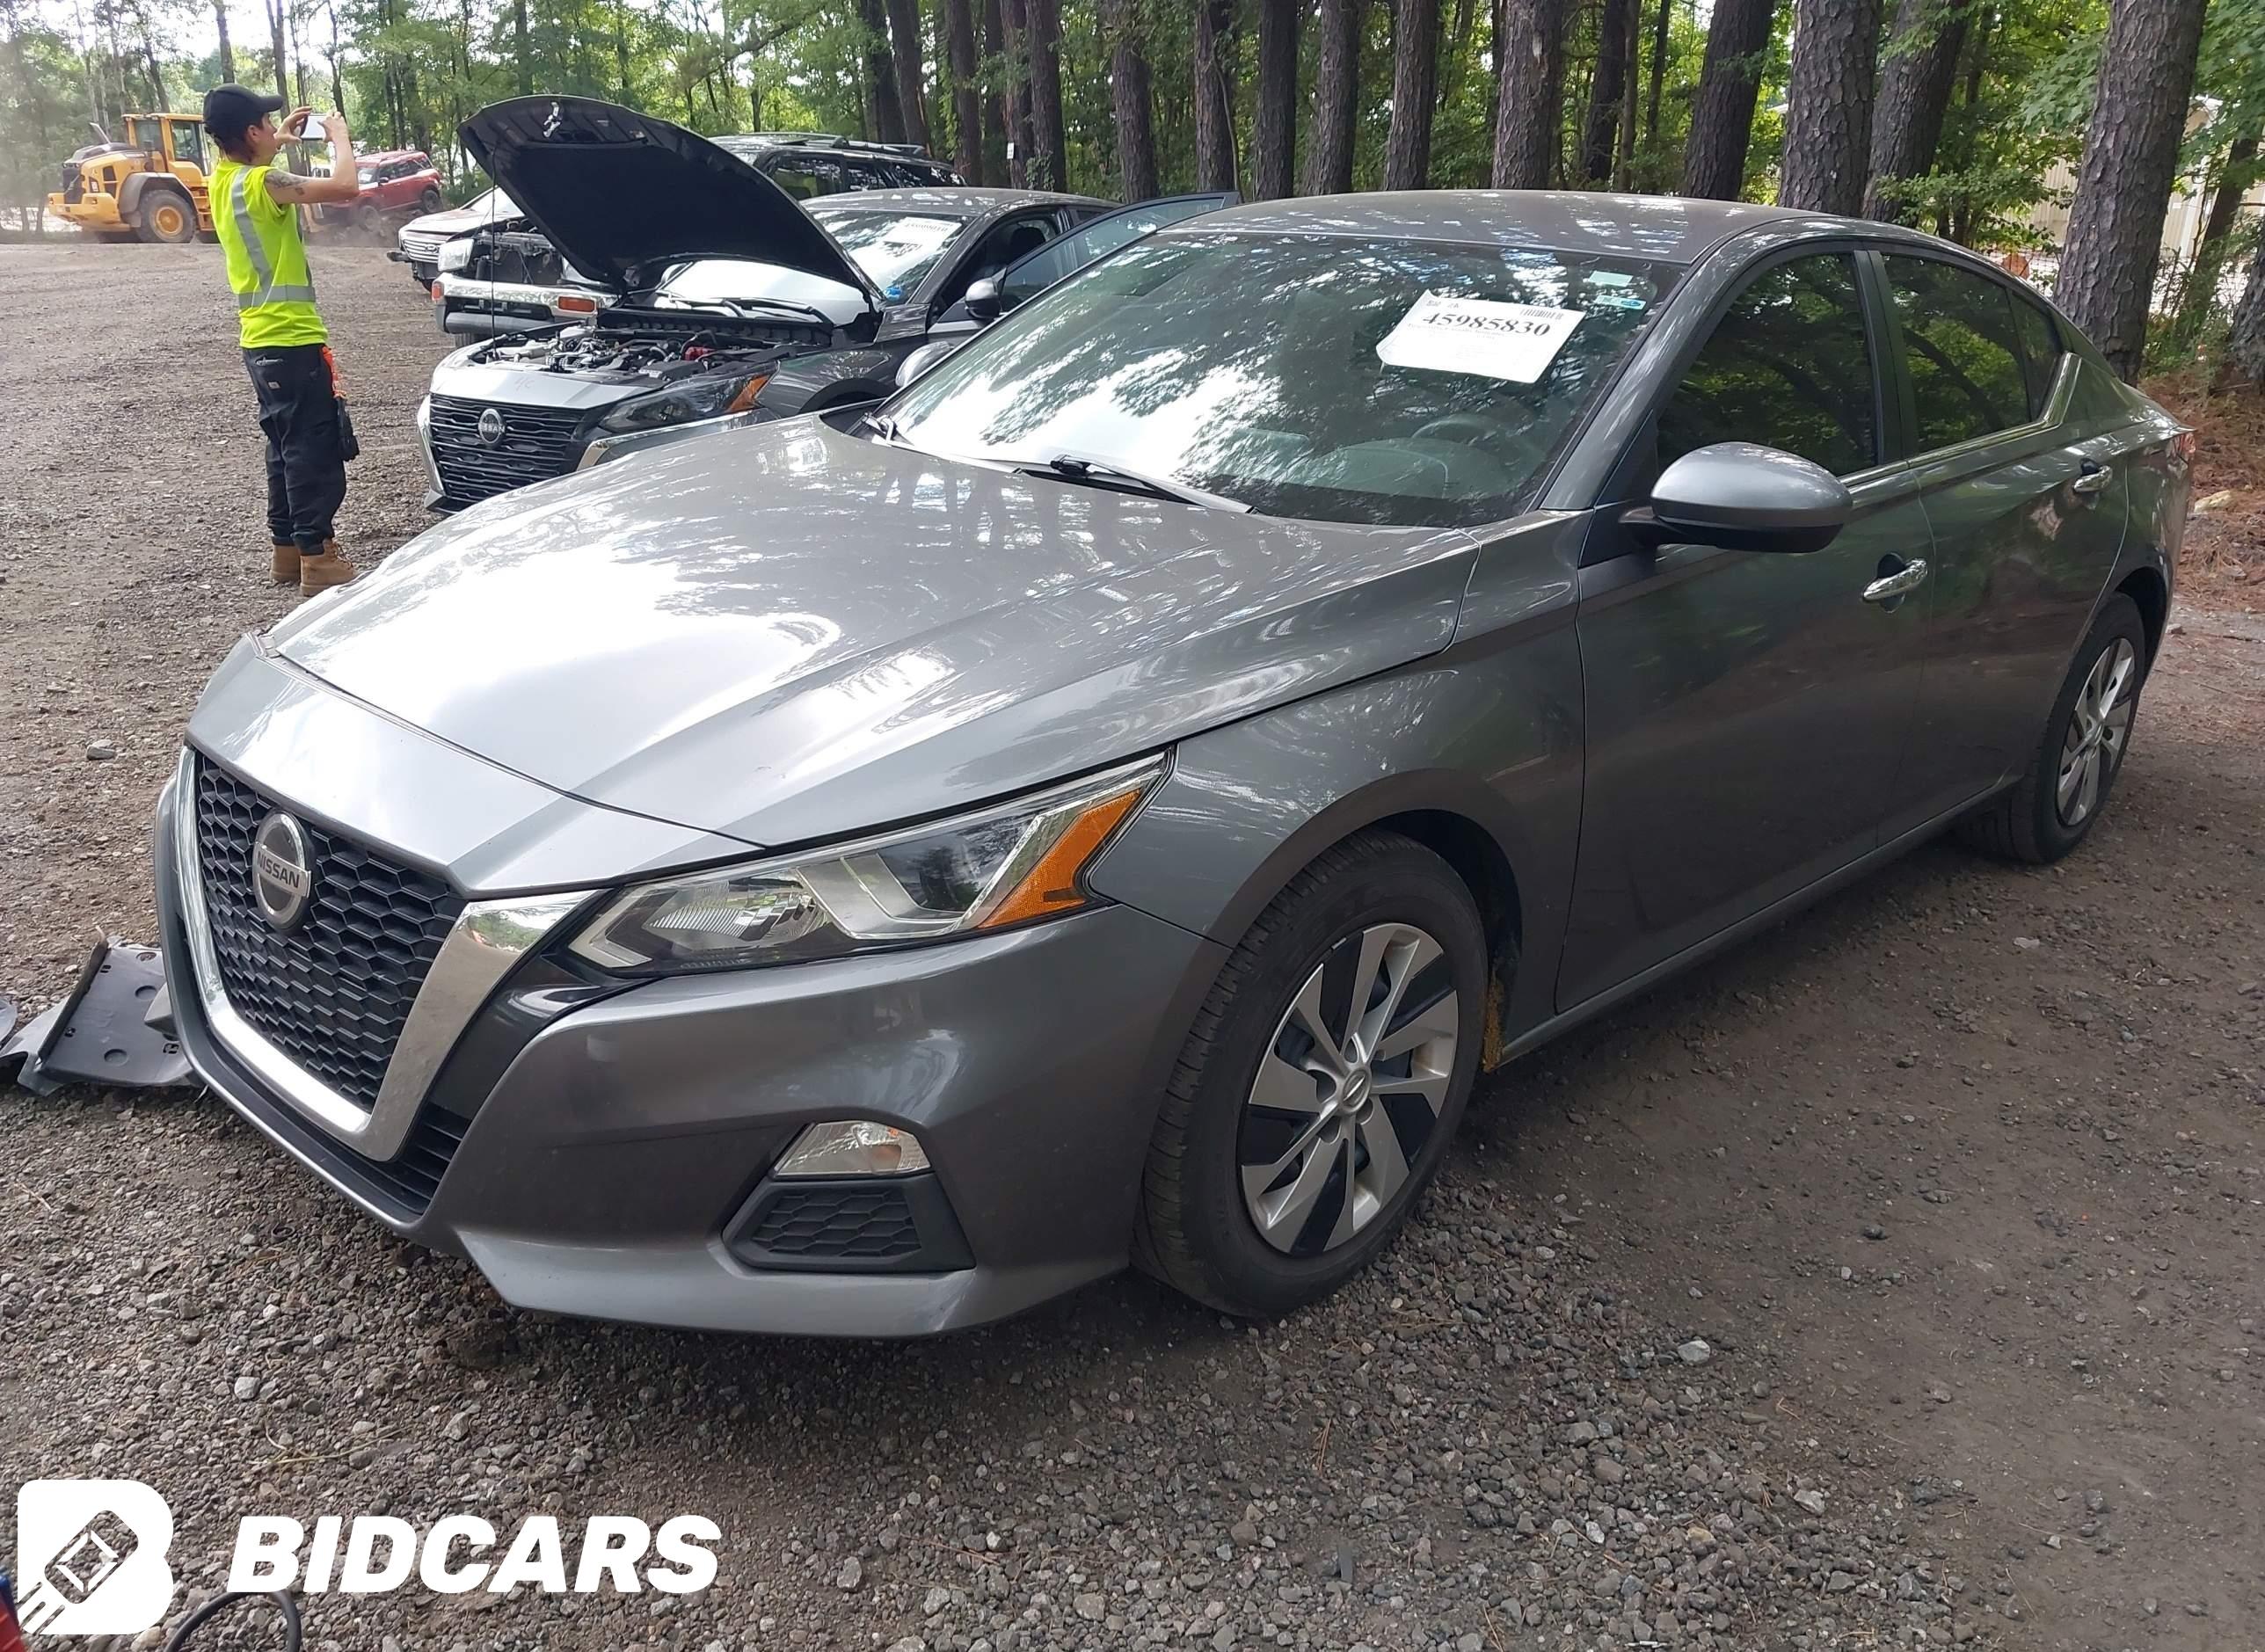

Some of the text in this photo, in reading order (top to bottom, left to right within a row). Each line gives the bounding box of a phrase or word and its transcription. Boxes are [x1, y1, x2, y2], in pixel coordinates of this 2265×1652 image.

[1422, 312, 1551, 336] 45985830
[478, 421, 506, 433] SSAN
[257, 850, 300, 888] NISSAN
